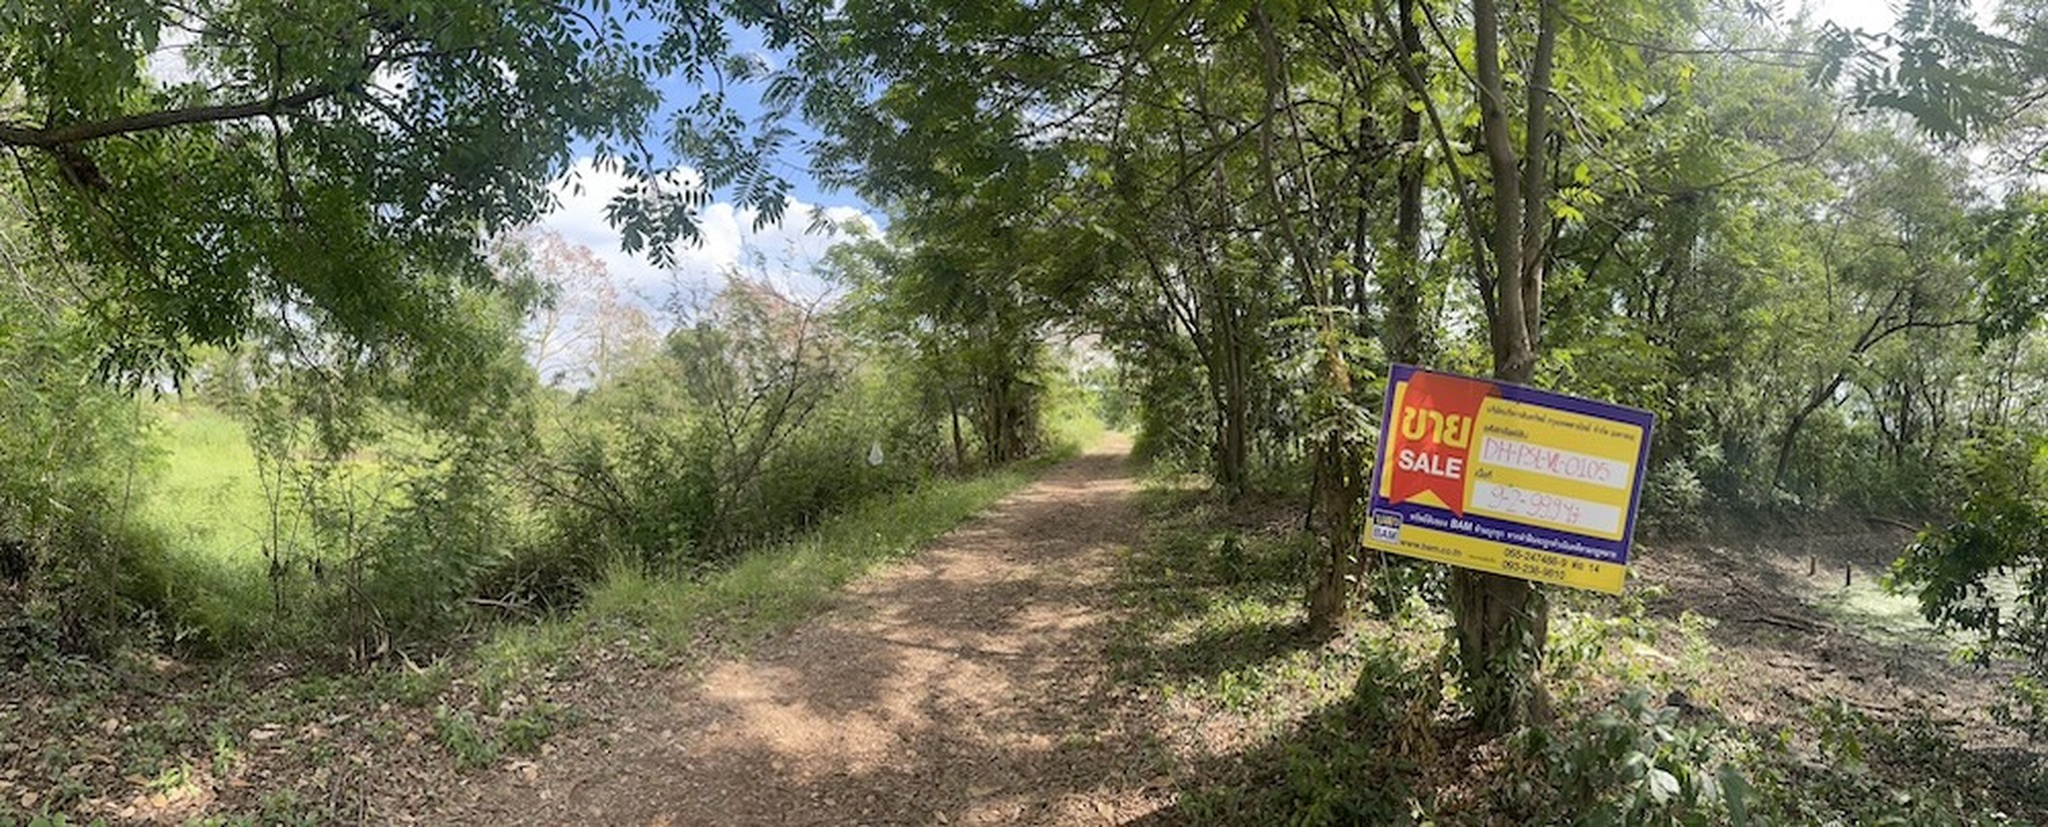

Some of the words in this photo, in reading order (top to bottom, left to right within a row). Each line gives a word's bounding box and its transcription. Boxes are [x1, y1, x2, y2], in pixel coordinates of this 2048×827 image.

[1401, 405, 1472, 449] ขาย
[1398, 448, 1463, 480] SALE
[1450, 518, 1473, 531] BAM
